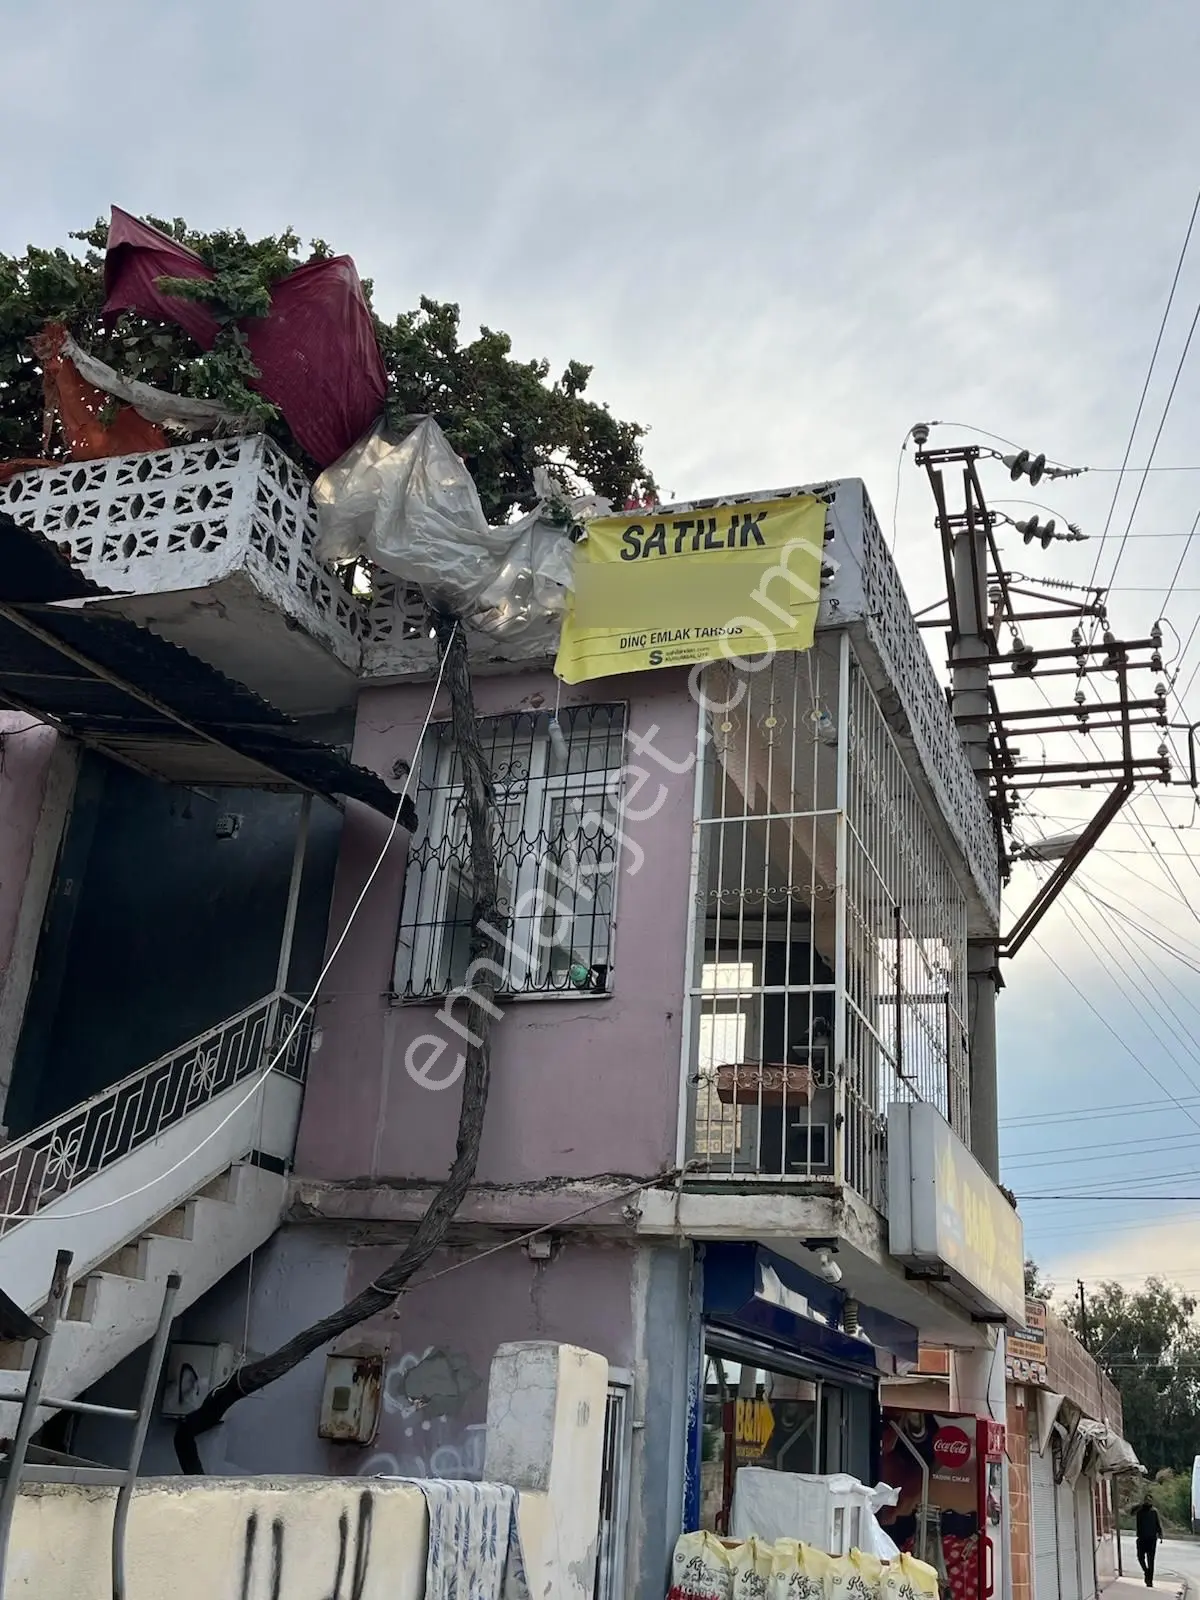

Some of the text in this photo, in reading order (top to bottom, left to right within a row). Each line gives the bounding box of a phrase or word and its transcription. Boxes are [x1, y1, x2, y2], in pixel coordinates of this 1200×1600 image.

[620, 511, 768, 561] SATILIK
[620, 633, 647, 649] DİNÇ
[650, 628, 691, 644] EMLAK
